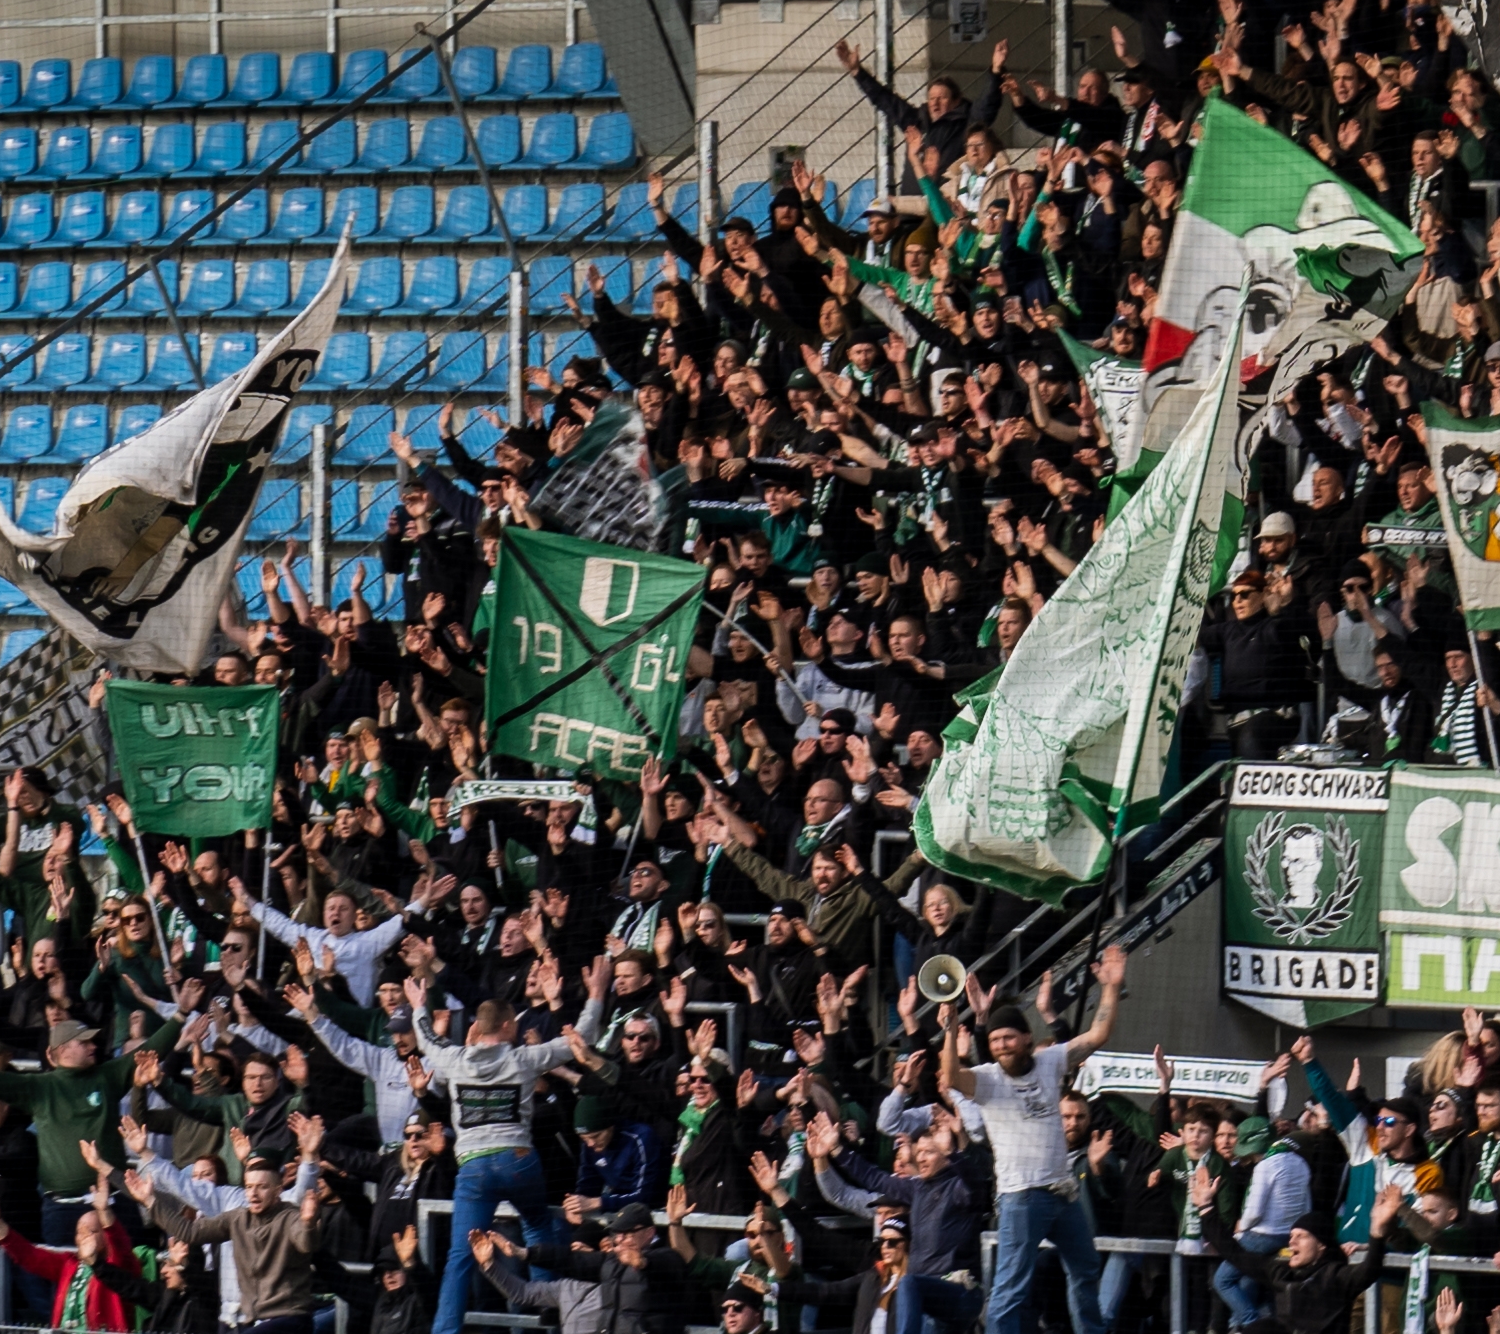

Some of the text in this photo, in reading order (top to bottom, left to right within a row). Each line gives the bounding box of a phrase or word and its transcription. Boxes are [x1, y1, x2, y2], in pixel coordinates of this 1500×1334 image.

[512, 615, 563, 675] 19
[1237, 765, 1386, 799] GEORG SCHWARZ
[1228, 951, 1376, 992] BRIGADE
[1194, 1068, 1250, 1085] LEIPZIG
